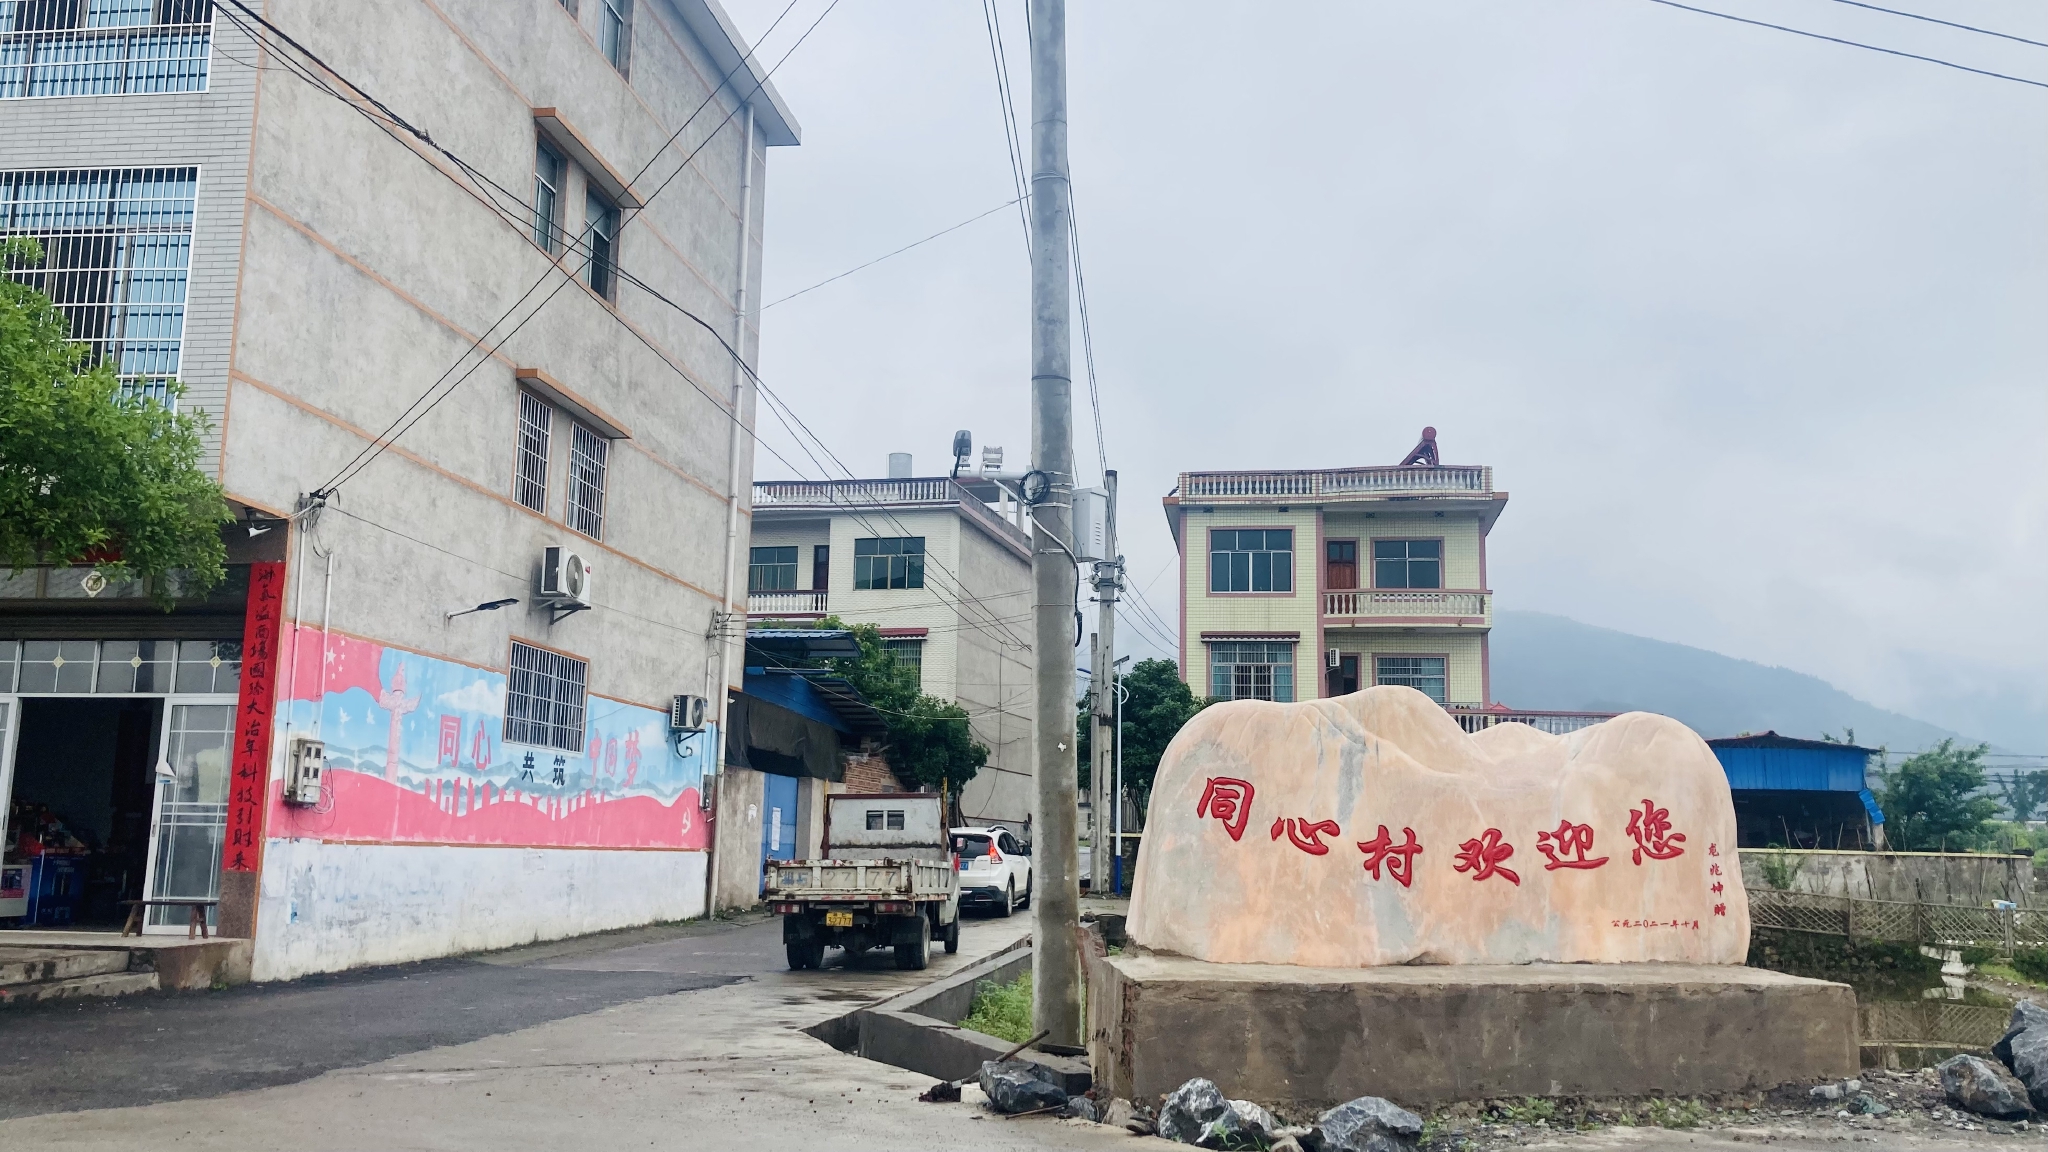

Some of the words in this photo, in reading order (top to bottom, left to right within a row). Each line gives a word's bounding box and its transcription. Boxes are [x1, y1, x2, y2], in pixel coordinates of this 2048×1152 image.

[1197, 777, 1686, 887] 同心村欢迎您
